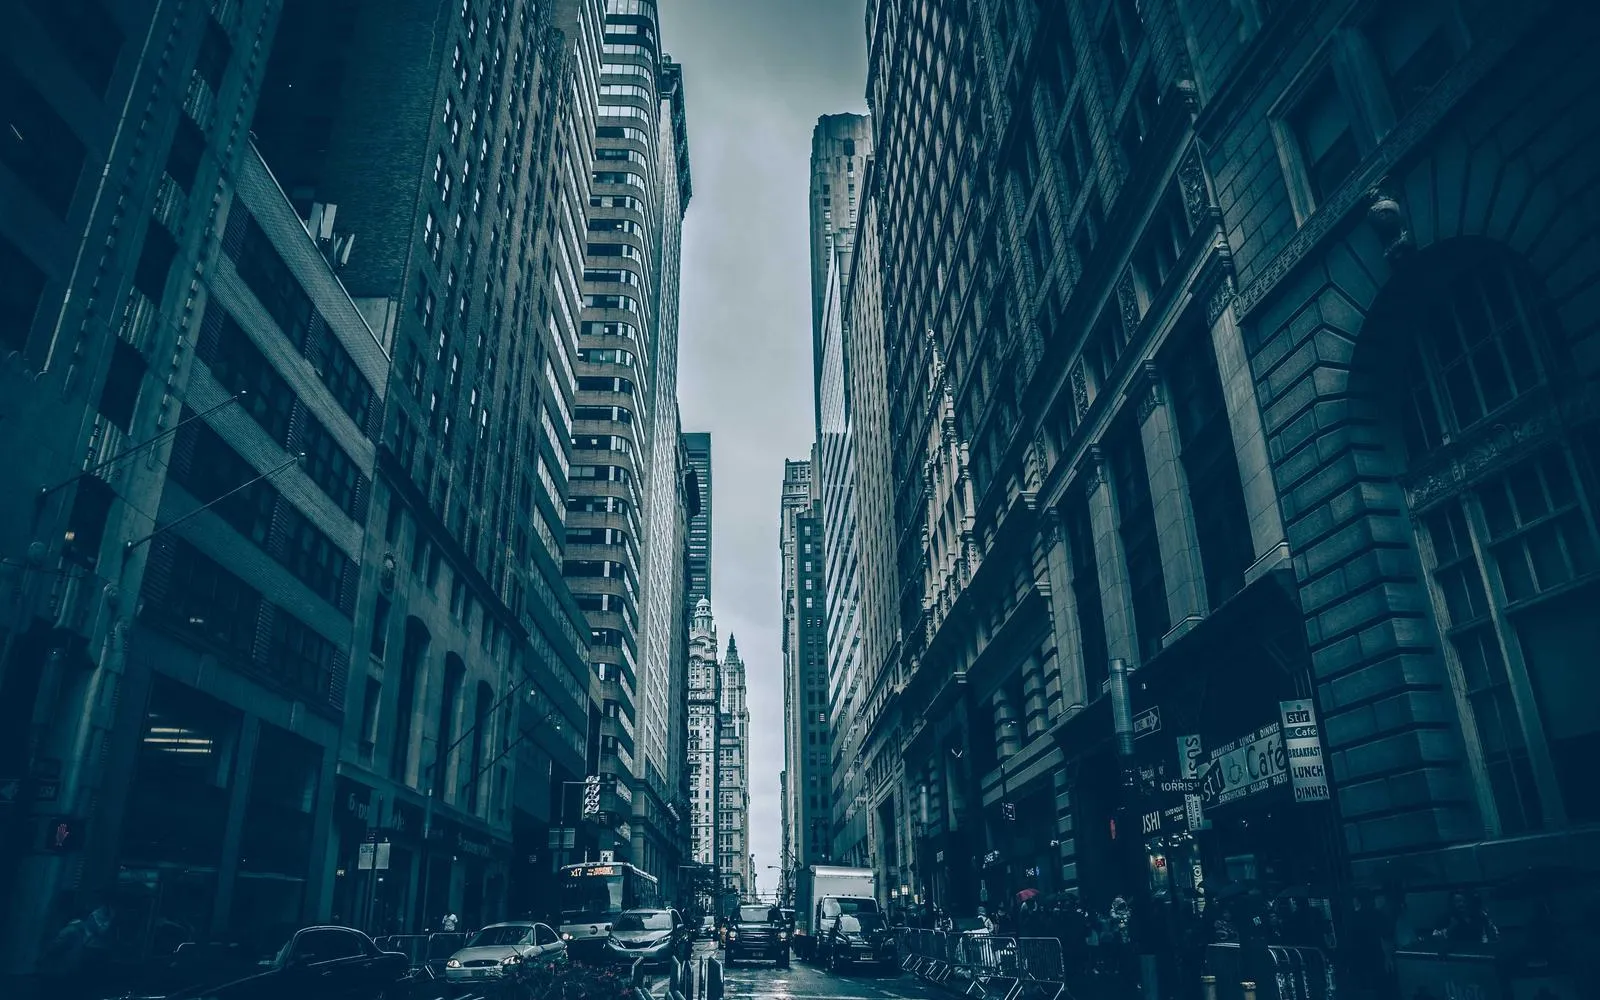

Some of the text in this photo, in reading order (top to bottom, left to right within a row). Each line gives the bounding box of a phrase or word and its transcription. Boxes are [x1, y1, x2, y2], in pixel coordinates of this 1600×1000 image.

[1239, 732, 1256, 748] LUNCH
[1259, 721, 1280, 739] DINNER
[1294, 726, 1318, 738] Café
[1247, 737, 1287, 781] Café
[1288, 746, 1321, 758] BREAKFAST
[1292, 765, 1324, 779] LUNCH
[1250, 779, 1269, 794] SALADS
[1295, 784, 1329, 800] DINNER
